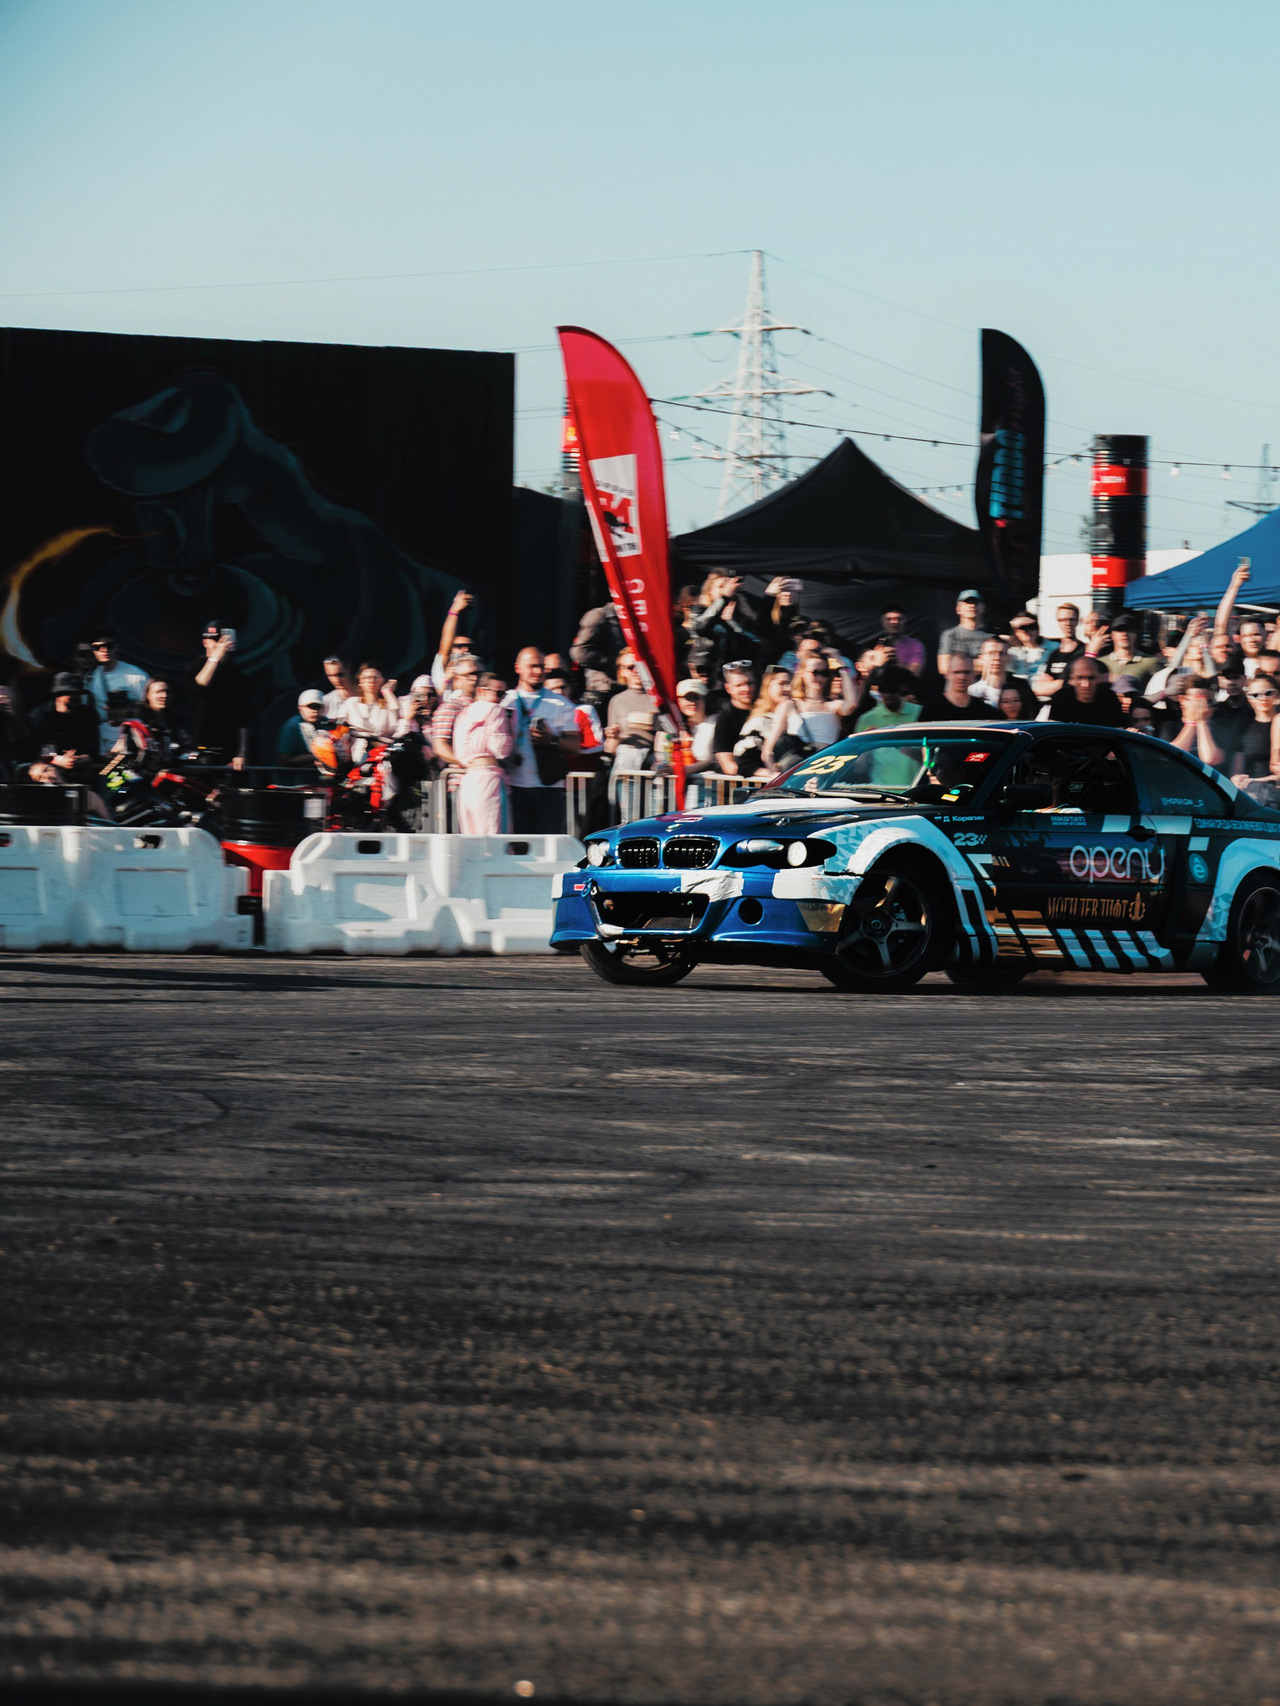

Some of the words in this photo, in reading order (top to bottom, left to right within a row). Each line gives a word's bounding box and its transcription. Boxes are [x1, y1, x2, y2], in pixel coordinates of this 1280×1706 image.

[988, 429, 1024, 519] TURBO
[793, 755, 859, 776] 23
[954, 832, 979, 847] 23
